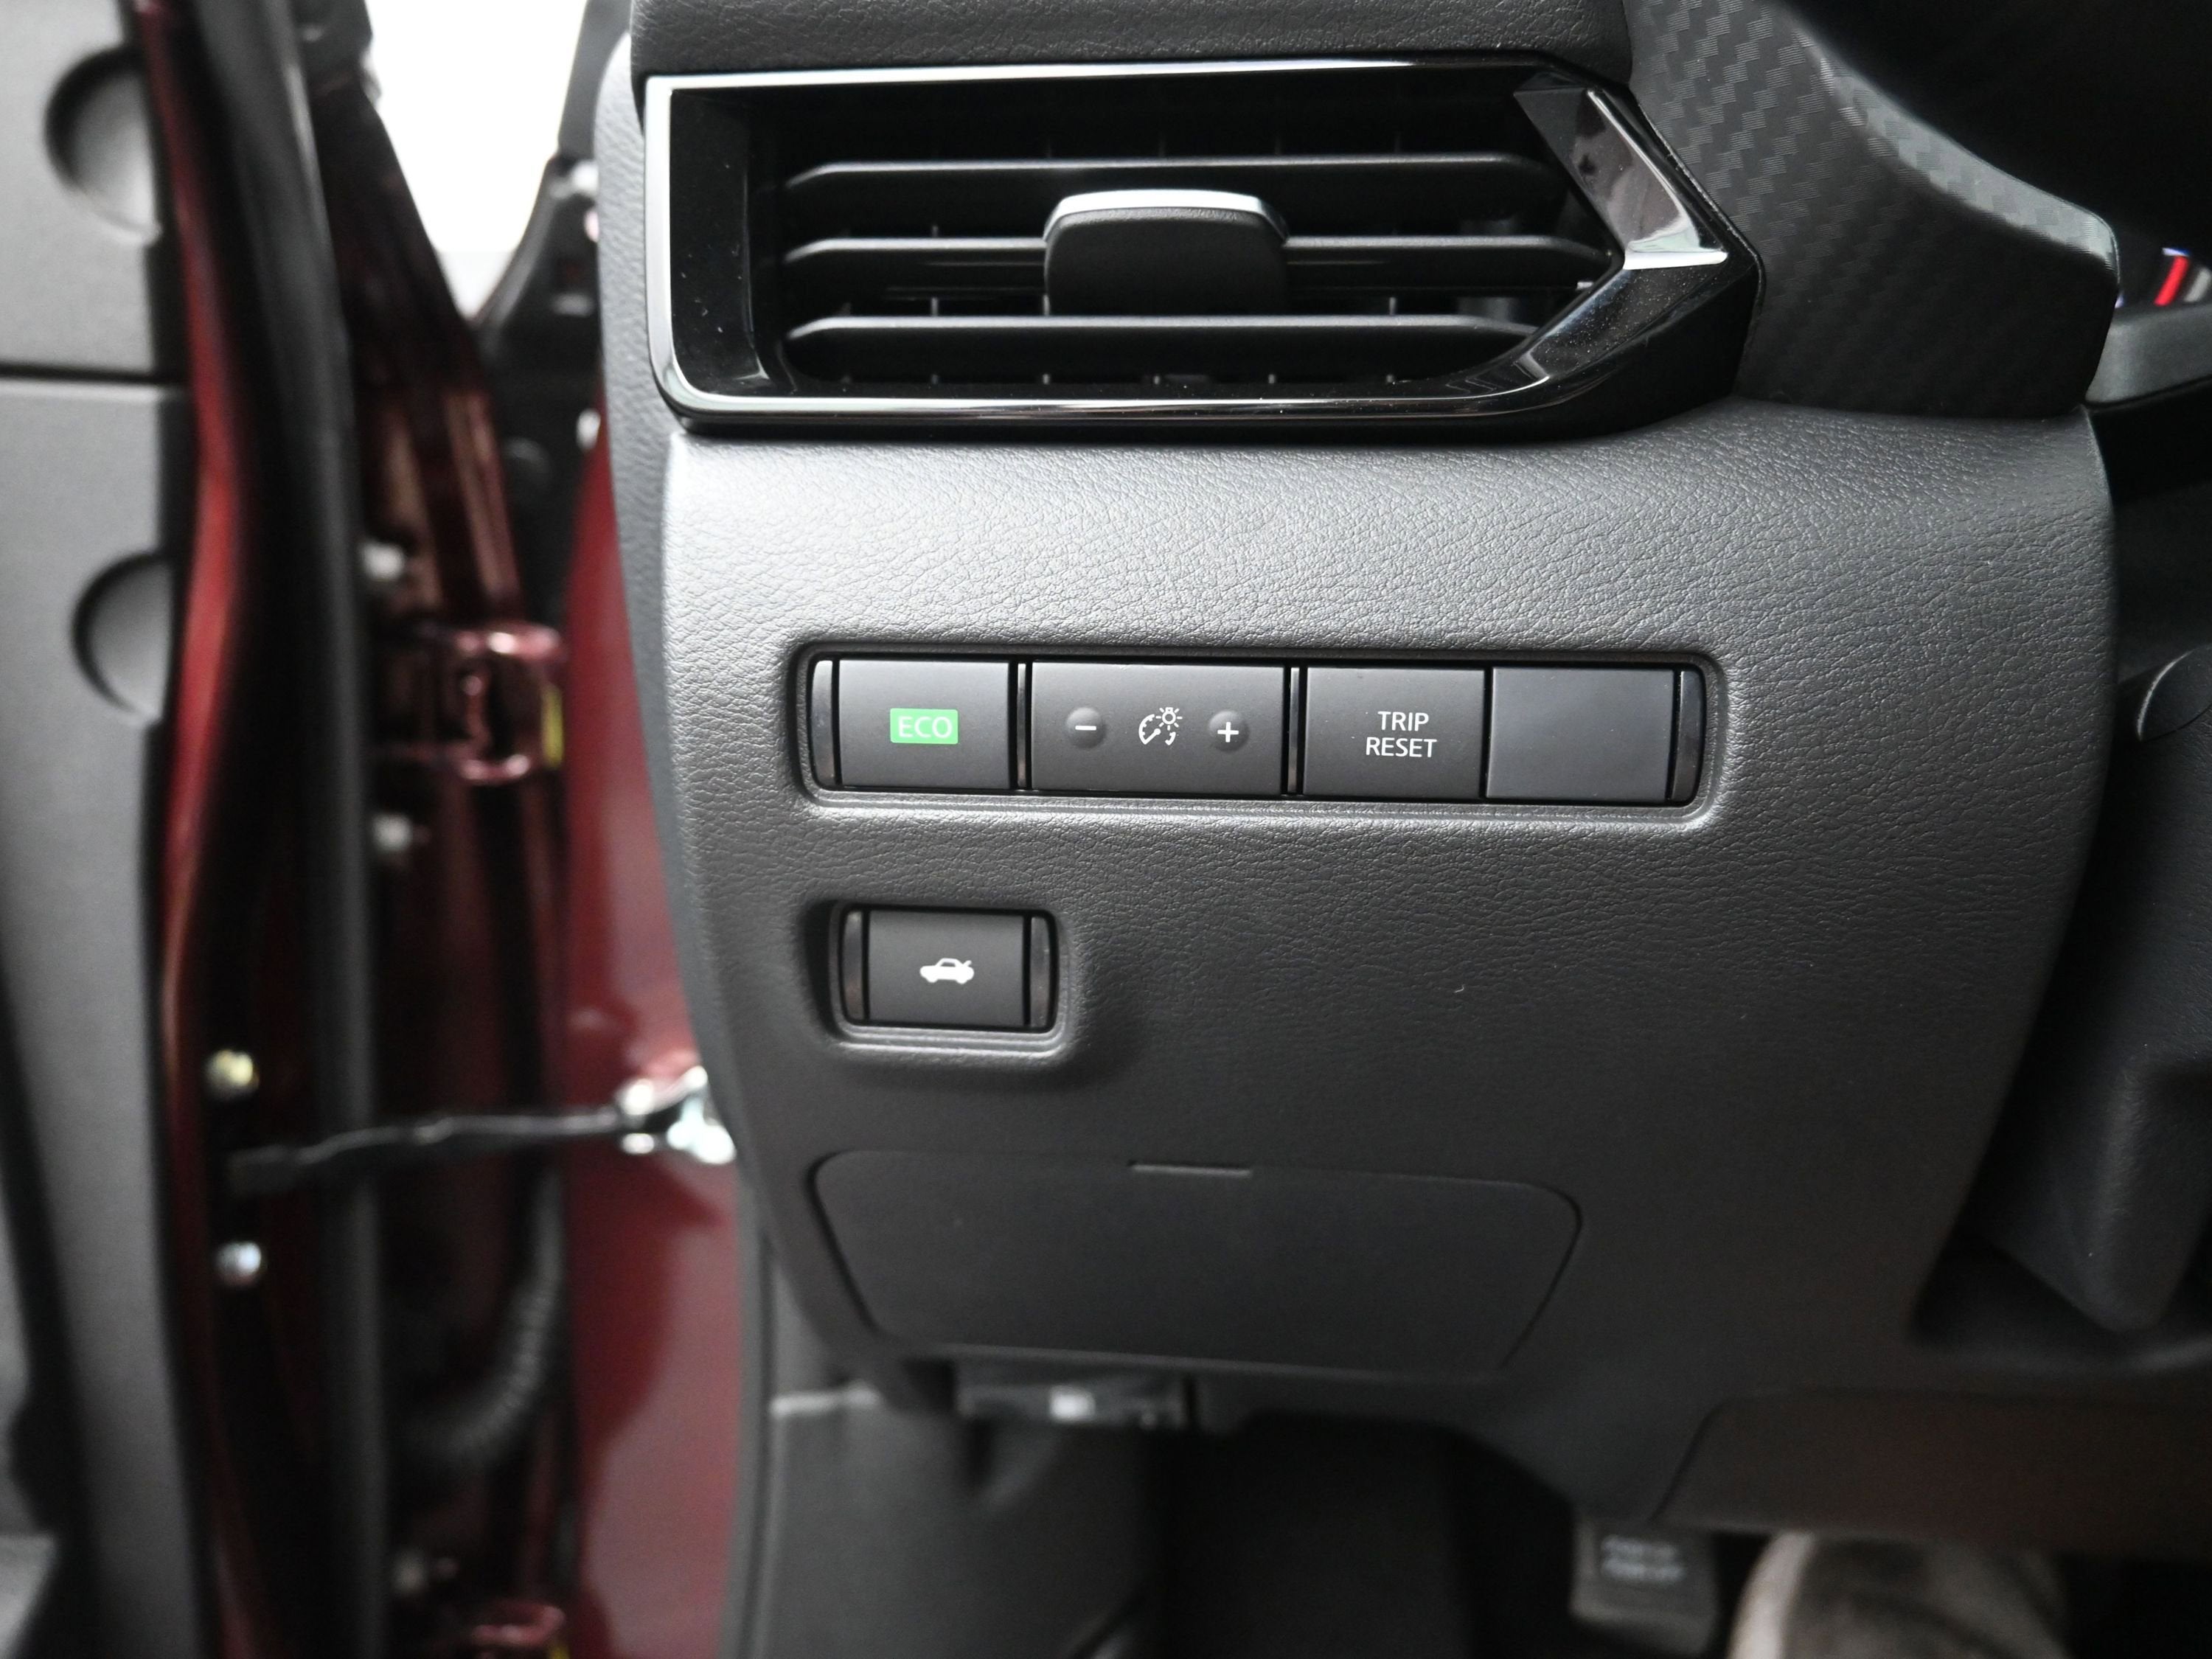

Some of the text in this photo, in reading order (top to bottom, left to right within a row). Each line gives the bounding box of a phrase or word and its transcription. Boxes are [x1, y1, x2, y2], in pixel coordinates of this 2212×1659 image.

[897, 715, 953, 740] ECO
[1377, 711, 1430, 731] TRIP
[1366, 737, 1438, 758] RESET
